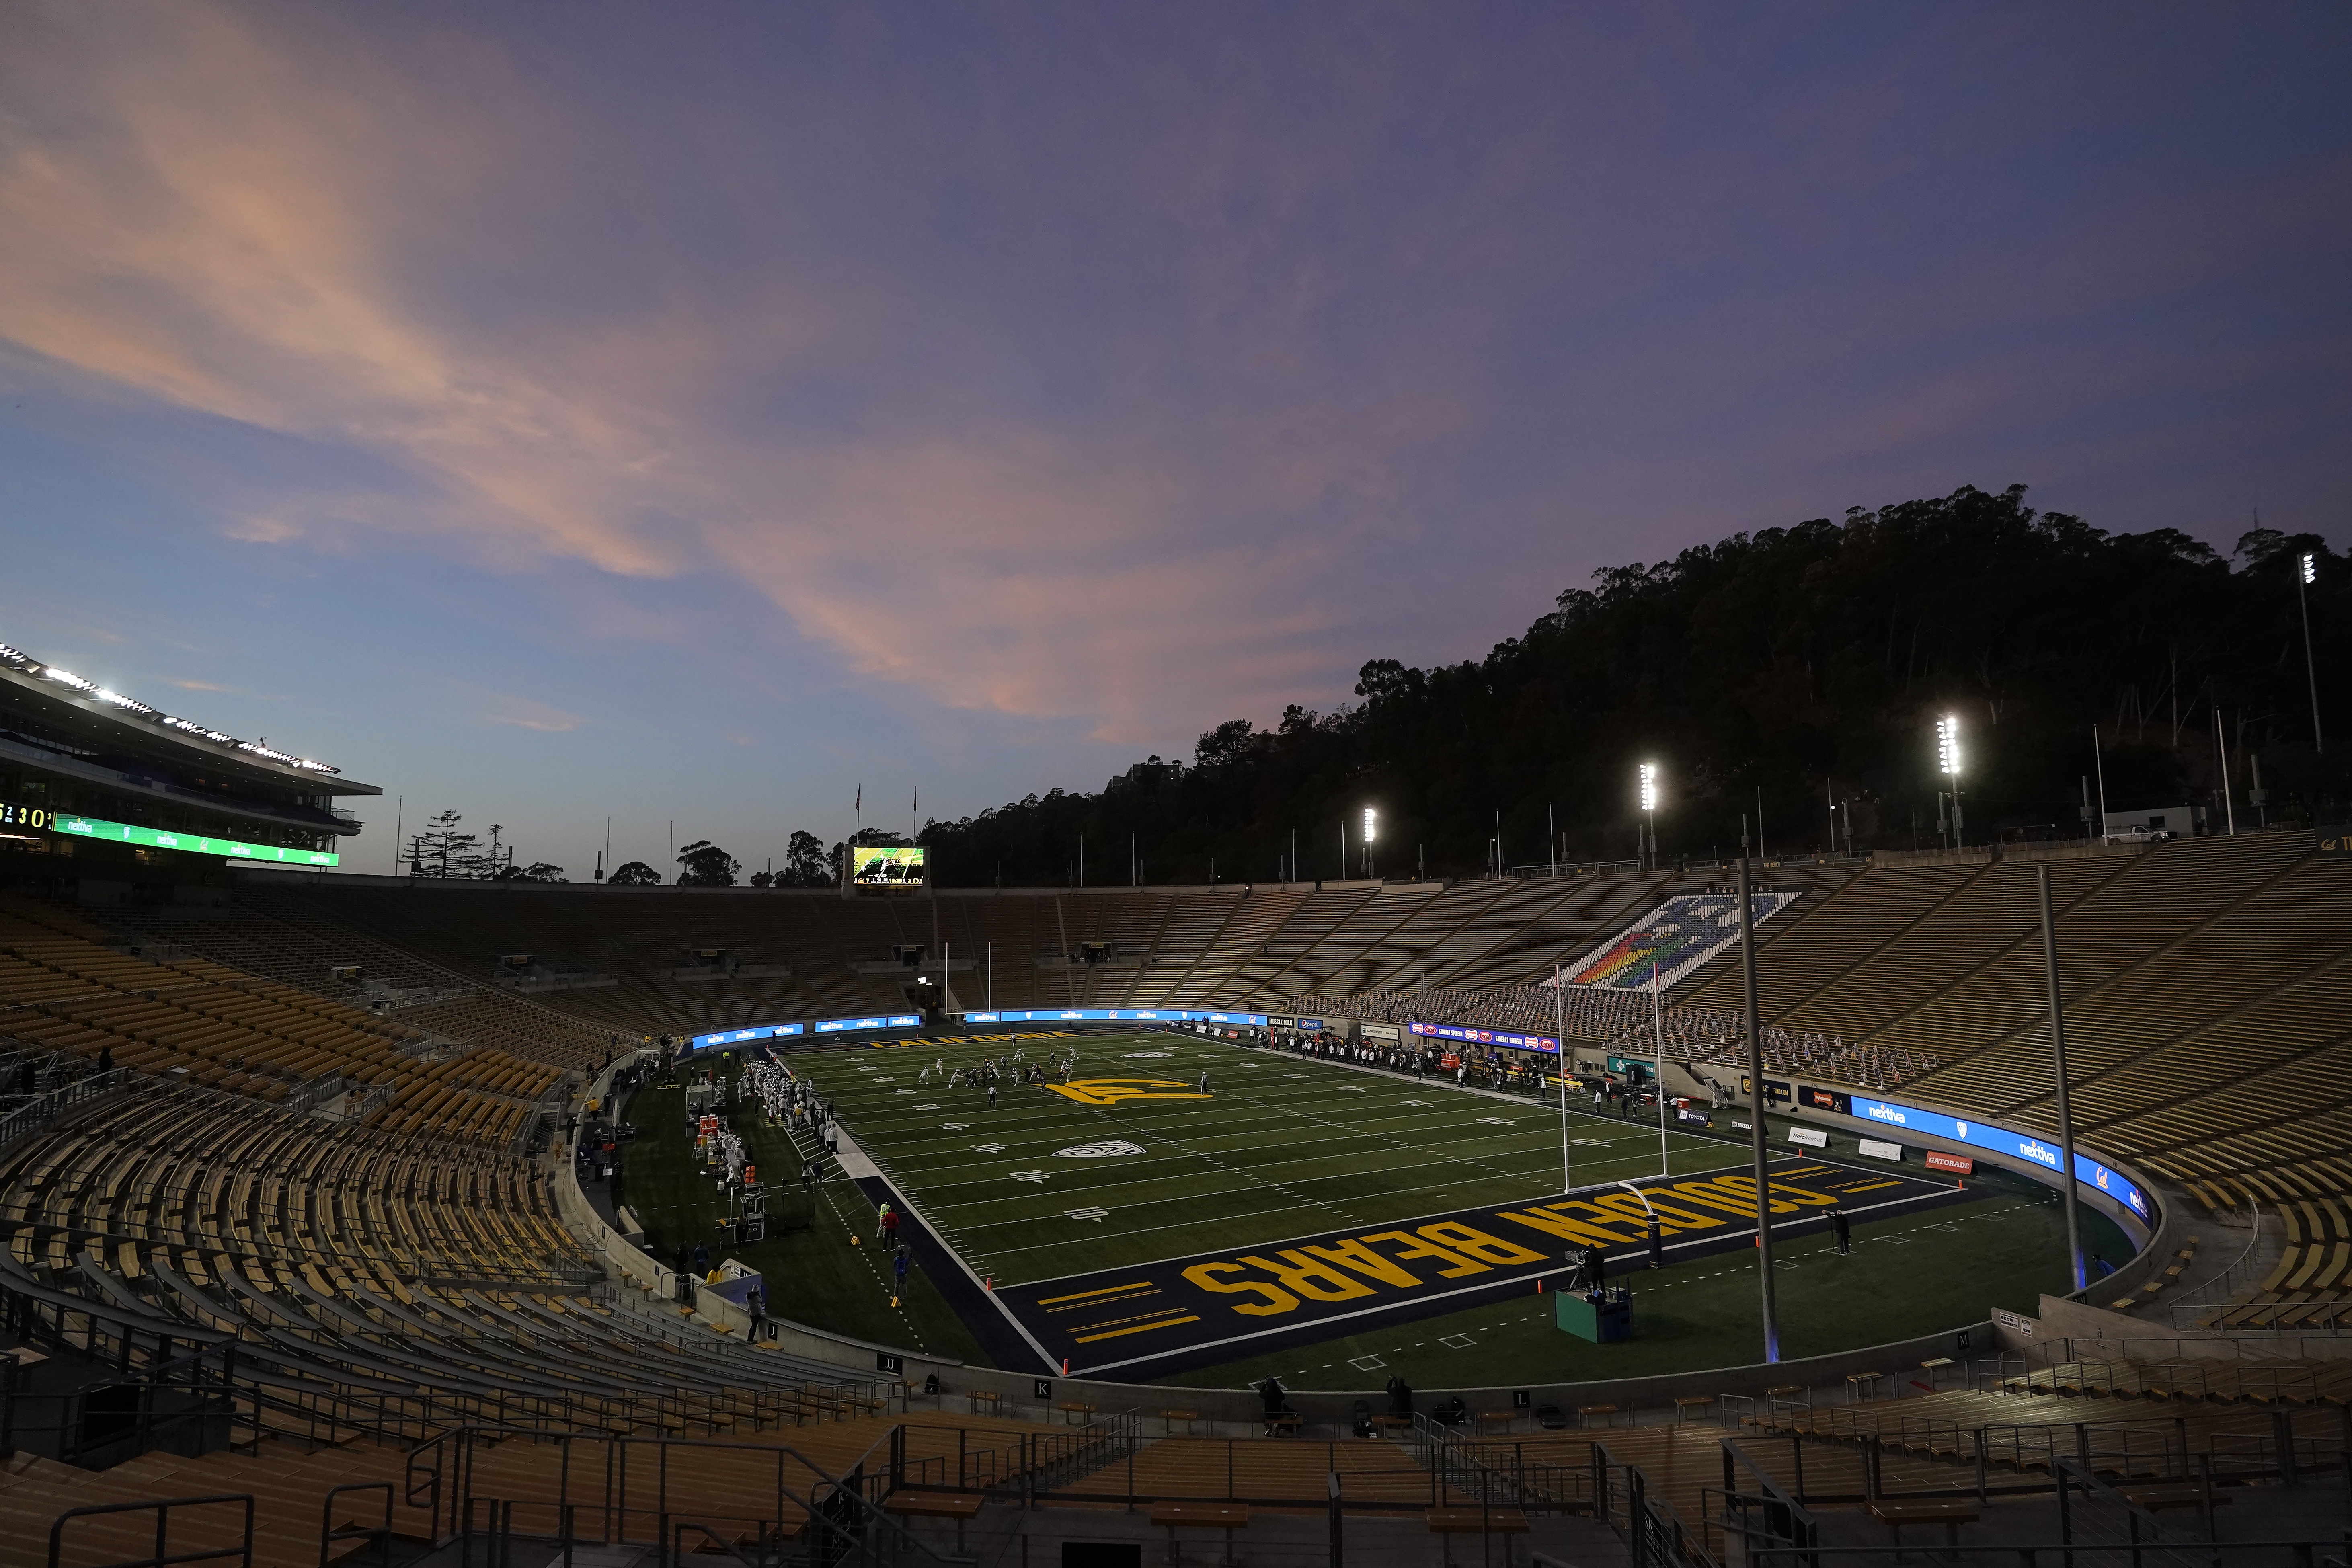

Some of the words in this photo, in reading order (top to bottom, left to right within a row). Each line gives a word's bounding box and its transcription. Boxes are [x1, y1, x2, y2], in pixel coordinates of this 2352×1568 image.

[7, 806, 12, 816] 2
[19, 808, 27, 824] 3
[68, 821, 92, 833] nextiva
[157, 835, 177, 846] nextiva
[2321, 839, 2337, 851] Cal
[230, 846, 251, 856] nextiva
[310, 855, 329, 864] nextiva
[1109, 1010, 1118, 1018] Cal
[821, 1022, 843, 1030] nextiva
[707, 1036, 724, 1044] nextiva
[870, 1032, 1081, 1048] CALIFORNIA
[1869, 1106, 1905, 1123] nextiva
[2020, 1143, 2056, 1165] nextiva
[1929, 1157, 1970, 1169] GATORADE
[2096, 1166, 2108, 1189] Cal
[1495, 1175, 1839, 1248] GOLDEN
[1181, 1221, 1550, 1316] BEARS
[771, 1326, 774, 1336] J
[1960, 1334, 1968, 1346] M
[885, 1357, 894, 1369] JJ
[1038, 1382, 1047, 1395] K
[1518, 1393, 1526, 1405] L
